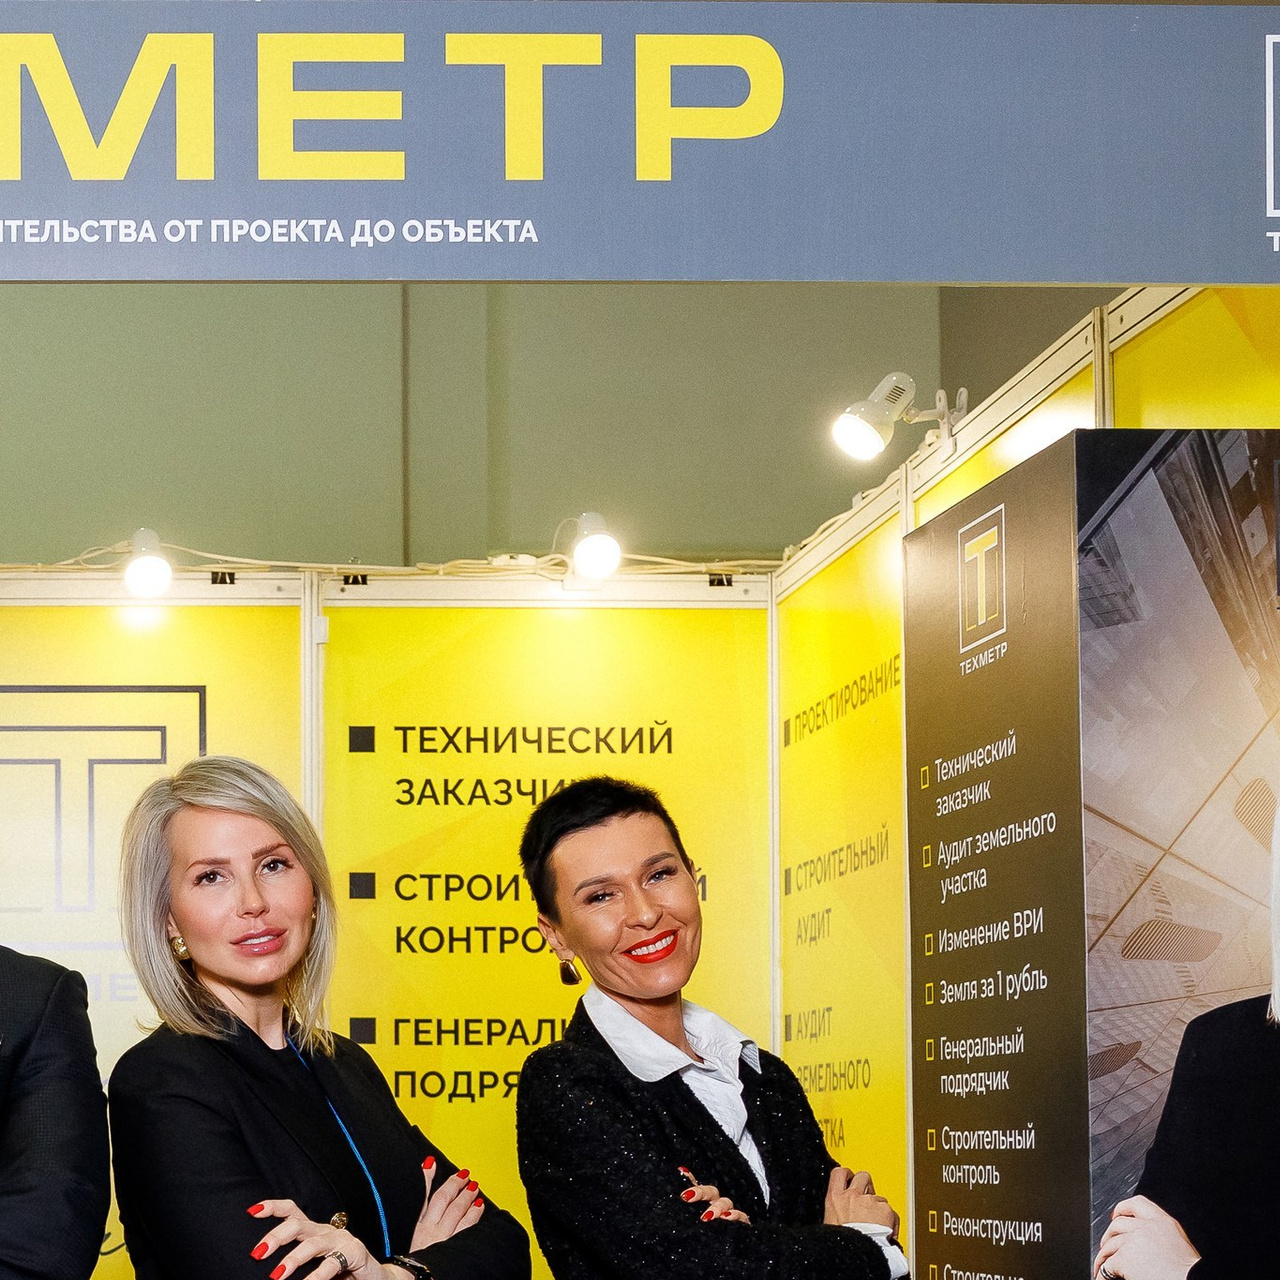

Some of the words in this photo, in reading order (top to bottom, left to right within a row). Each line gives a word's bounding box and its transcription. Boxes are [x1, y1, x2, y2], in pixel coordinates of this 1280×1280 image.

[163, 219, 203, 242] ОТ
[210, 219, 345, 242] ПРОЕКТА
[350, 219, 396, 248] ДО
[402, 219, 539, 242] ОБЪЕКТА
[959, 641, 1009, 678] ТЕХМЕТР
[794, 653, 901, 744] ПРОЕКТИРОВАНИЕ
[394, 719, 674, 755] ТЕХНИЧЕСКИЙ
[934, 728, 1017, 783] Технический
[395, 778, 578, 806] ЗАКАЗЧИ
[935, 780, 992, 818] заказчик
[795, 821, 890, 892] СТРОИТЕЛЬНЫЙ
[937, 836, 974, 870] Аудит
[974, 811, 1057, 854] земельного
[940, 867, 988, 904] участка
[394, 926, 554, 954] КОНТРО
[795, 907, 832, 948] АУДИТ
[938, 919, 1011, 954] Изменение
[1013, 906, 1044, 939] ВРИ
[939, 979, 978, 1005] Земля
[980, 976, 995, 999] за
[996, 970, 1003, 996] 1
[1005, 962, 1048, 1001] рубль
[796, 1006, 833, 1044] АУДИТ
[939, 1026, 1025, 1065] Генеральный
[939, 1070, 1010, 1099] подрядчик
[941, 1122, 1036, 1156] Строительный
[942, 1164, 1001, 1190] контроль
[943, 1211, 1043, 1246] Реконструкция
